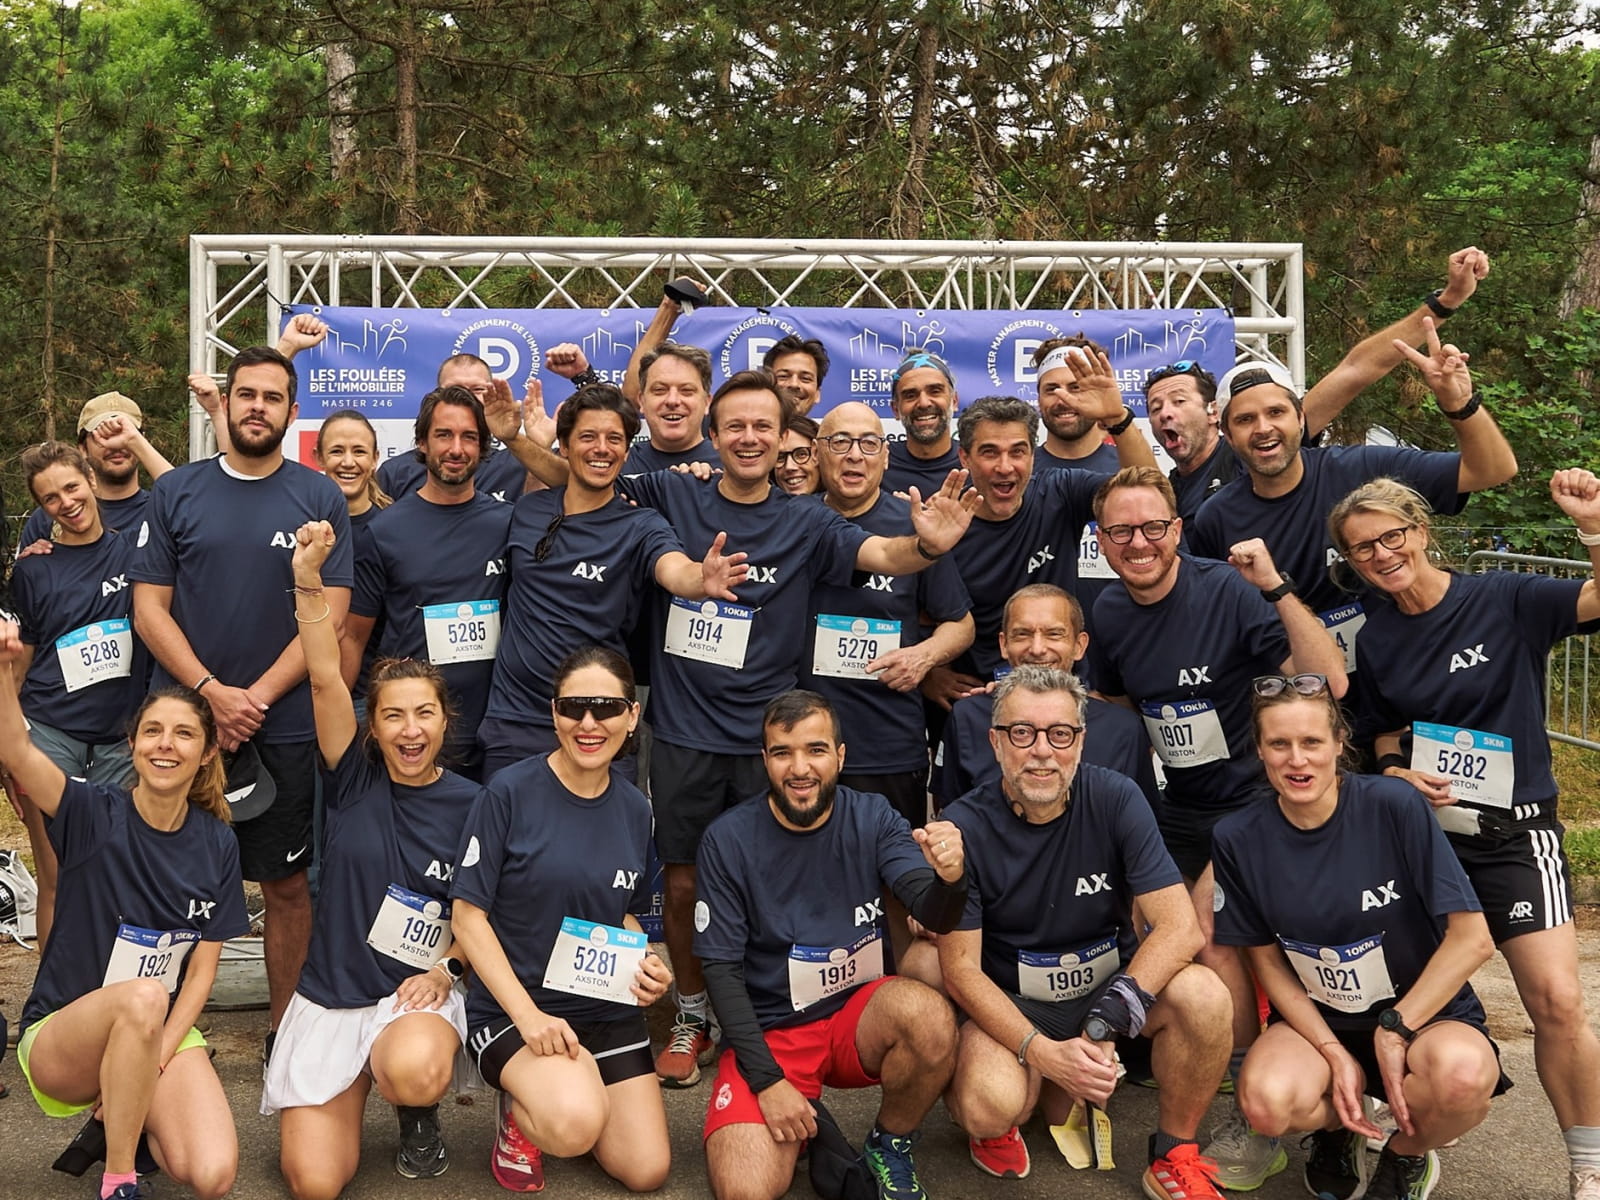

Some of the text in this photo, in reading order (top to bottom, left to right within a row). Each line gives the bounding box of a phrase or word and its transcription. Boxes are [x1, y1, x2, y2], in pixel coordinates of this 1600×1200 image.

[454, 318, 510, 349] MANAGEMENT
[512, 320, 525, 334] DE
[991, 319, 1044, 350] MANAGEMENT
[1046, 322, 1058, 335] DE
[720, 348, 731, 378] ASTER
[726, 317, 779, 348] MANAGEMENT
[780, 321, 793, 335] DE
[310, 366, 406, 382] LES FOULÉES
[595, 369, 608, 382] ES
[850, 368, 877, 381] LES
[988, 349, 1002, 387] MASTER
[1115, 369, 1141, 382] LES
[310, 382, 404, 392] DE L'IMMOBILIER
[850, 382, 868, 392] DE
[322, 400, 393, 408] MASTER 246
[862, 398, 891, 407] MAST
[1028, 544, 1056, 574] AX
[572, 562, 607, 582] AX
[745, 566, 778, 584] AX
[102, 573, 129, 597] AX
[724, 606, 749, 618] 10KM
[1328, 607, 1358, 622] 10KM
[448, 622, 486, 644] 5285
[688, 617, 724, 644] 1914
[80, 640, 120, 666] 5288
[456, 644, 484, 653] AXSTON
[688, 641, 718, 654] AXSTON
[838, 636, 878, 661] 5279
[841, 660, 868, 670] AXSTO
[1450, 644, 1490, 673] AX
[90, 662, 120, 674] AXSTON
[1178, 666, 1212, 686] AX
[1180, 702, 1208, 714] 10KM
[1158, 724, 1194, 748] 1907
[1483, 736, 1504, 748] 5KM
[1437, 750, 1488, 781] 5282
[612, 870, 638, 890] AX
[1075, 873, 1112, 896] AX
[1362, 880, 1402, 912] AX
[855, 896, 885, 928] AX
[402, 916, 442, 949] 1910
[616, 932, 639, 944] 5KM
[853, 932, 876, 950] 10KM
[400, 942, 431, 959] AXSTON
[1086, 942, 1112, 958] 10KM
[1345, 940, 1374, 958] 10KM
[137, 952, 172, 978] 1922
[574, 946, 618, 977] 5281
[575, 974, 610, 988] AXSTON
[818, 959, 856, 988] 1913
[1046, 967, 1094, 992] 1903
[1315, 966, 1361, 991] 1921
[823, 978, 854, 994] AXSTON
[1055, 985, 1090, 1000] AXSTON
[1327, 992, 1362, 1002] AXSTON
